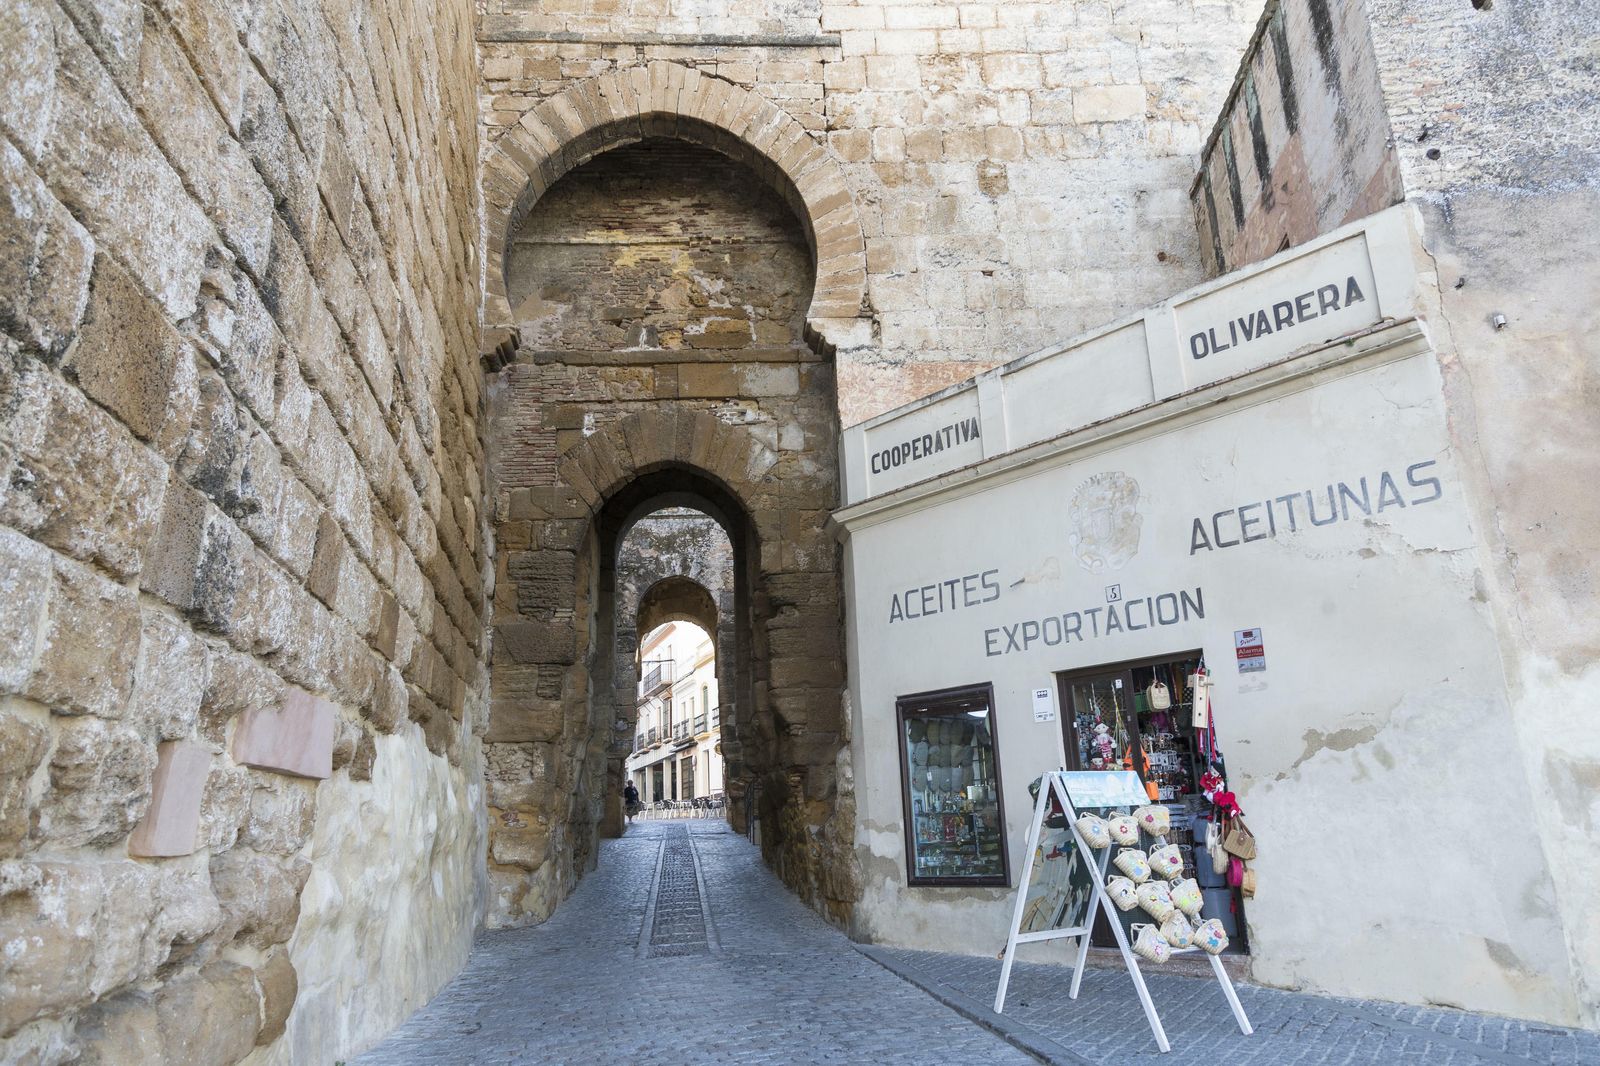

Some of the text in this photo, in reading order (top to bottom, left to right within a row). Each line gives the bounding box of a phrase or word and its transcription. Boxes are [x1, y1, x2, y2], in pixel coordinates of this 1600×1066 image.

[871, 275, 1366, 475] COOPERATIVA OLIVARERA
[1189, 460, 1443, 556] ACEITUNAS
[888, 568, 1001, 624] ACEITES
[984, 587, 1206, 657] EXPORTACION
[1110, 587, 1117, 600] 5
